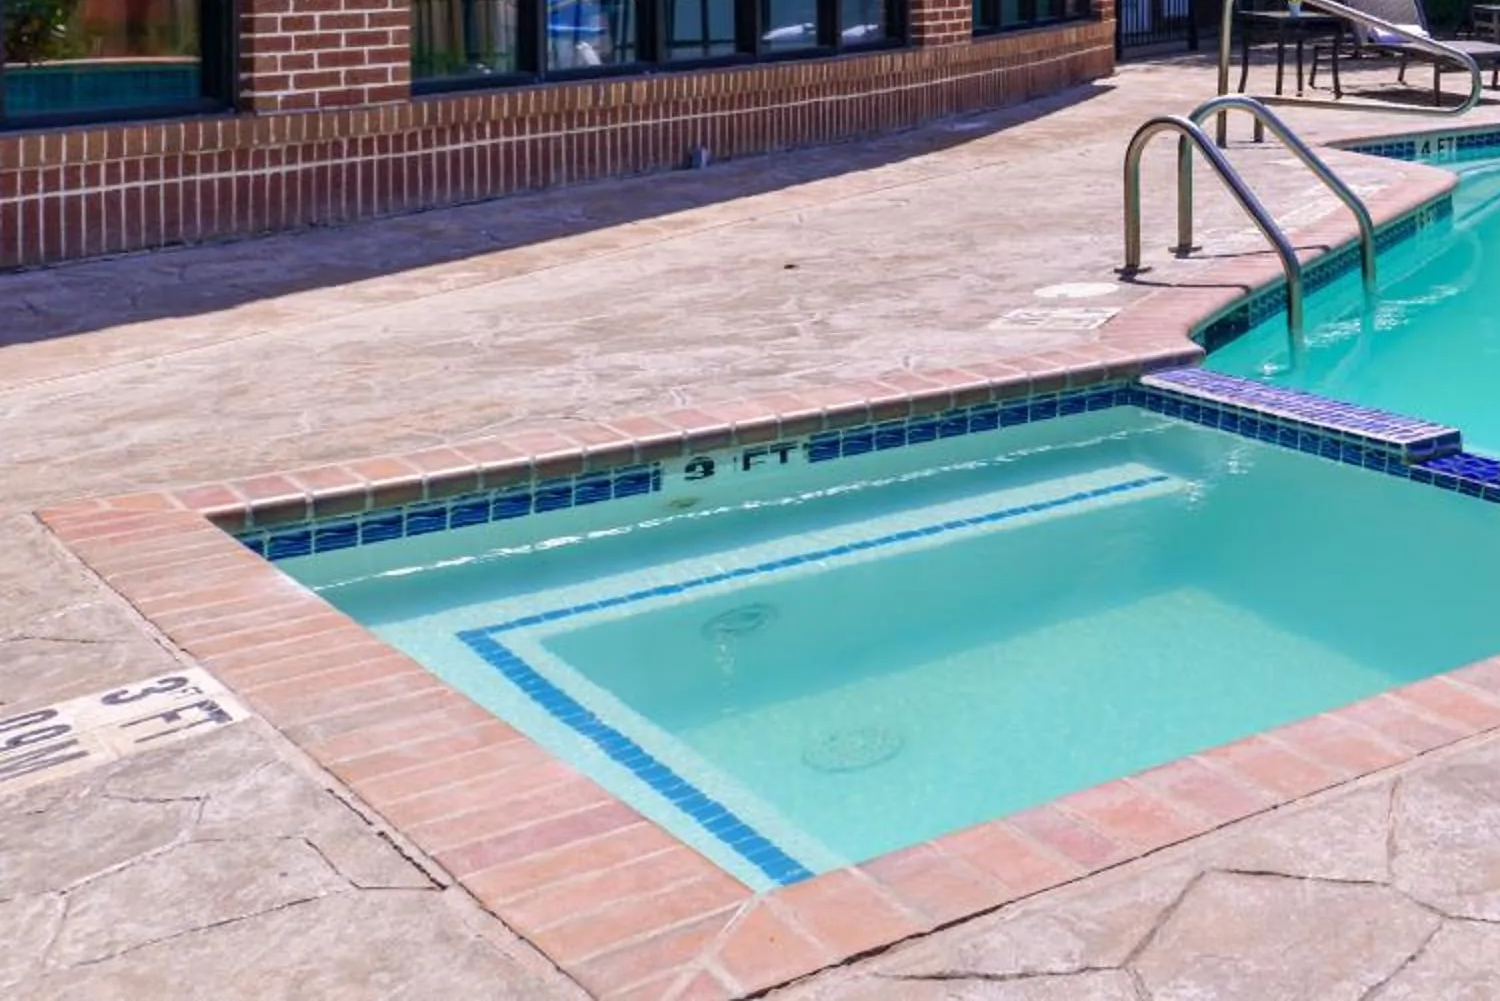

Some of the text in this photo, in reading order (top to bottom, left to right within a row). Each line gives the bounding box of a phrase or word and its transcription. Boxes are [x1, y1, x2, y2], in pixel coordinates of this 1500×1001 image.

[1421, 137, 1454, 153] 4 FT
[742, 442, 798, 471] FT
[101, 676, 233, 743] 3 FT
